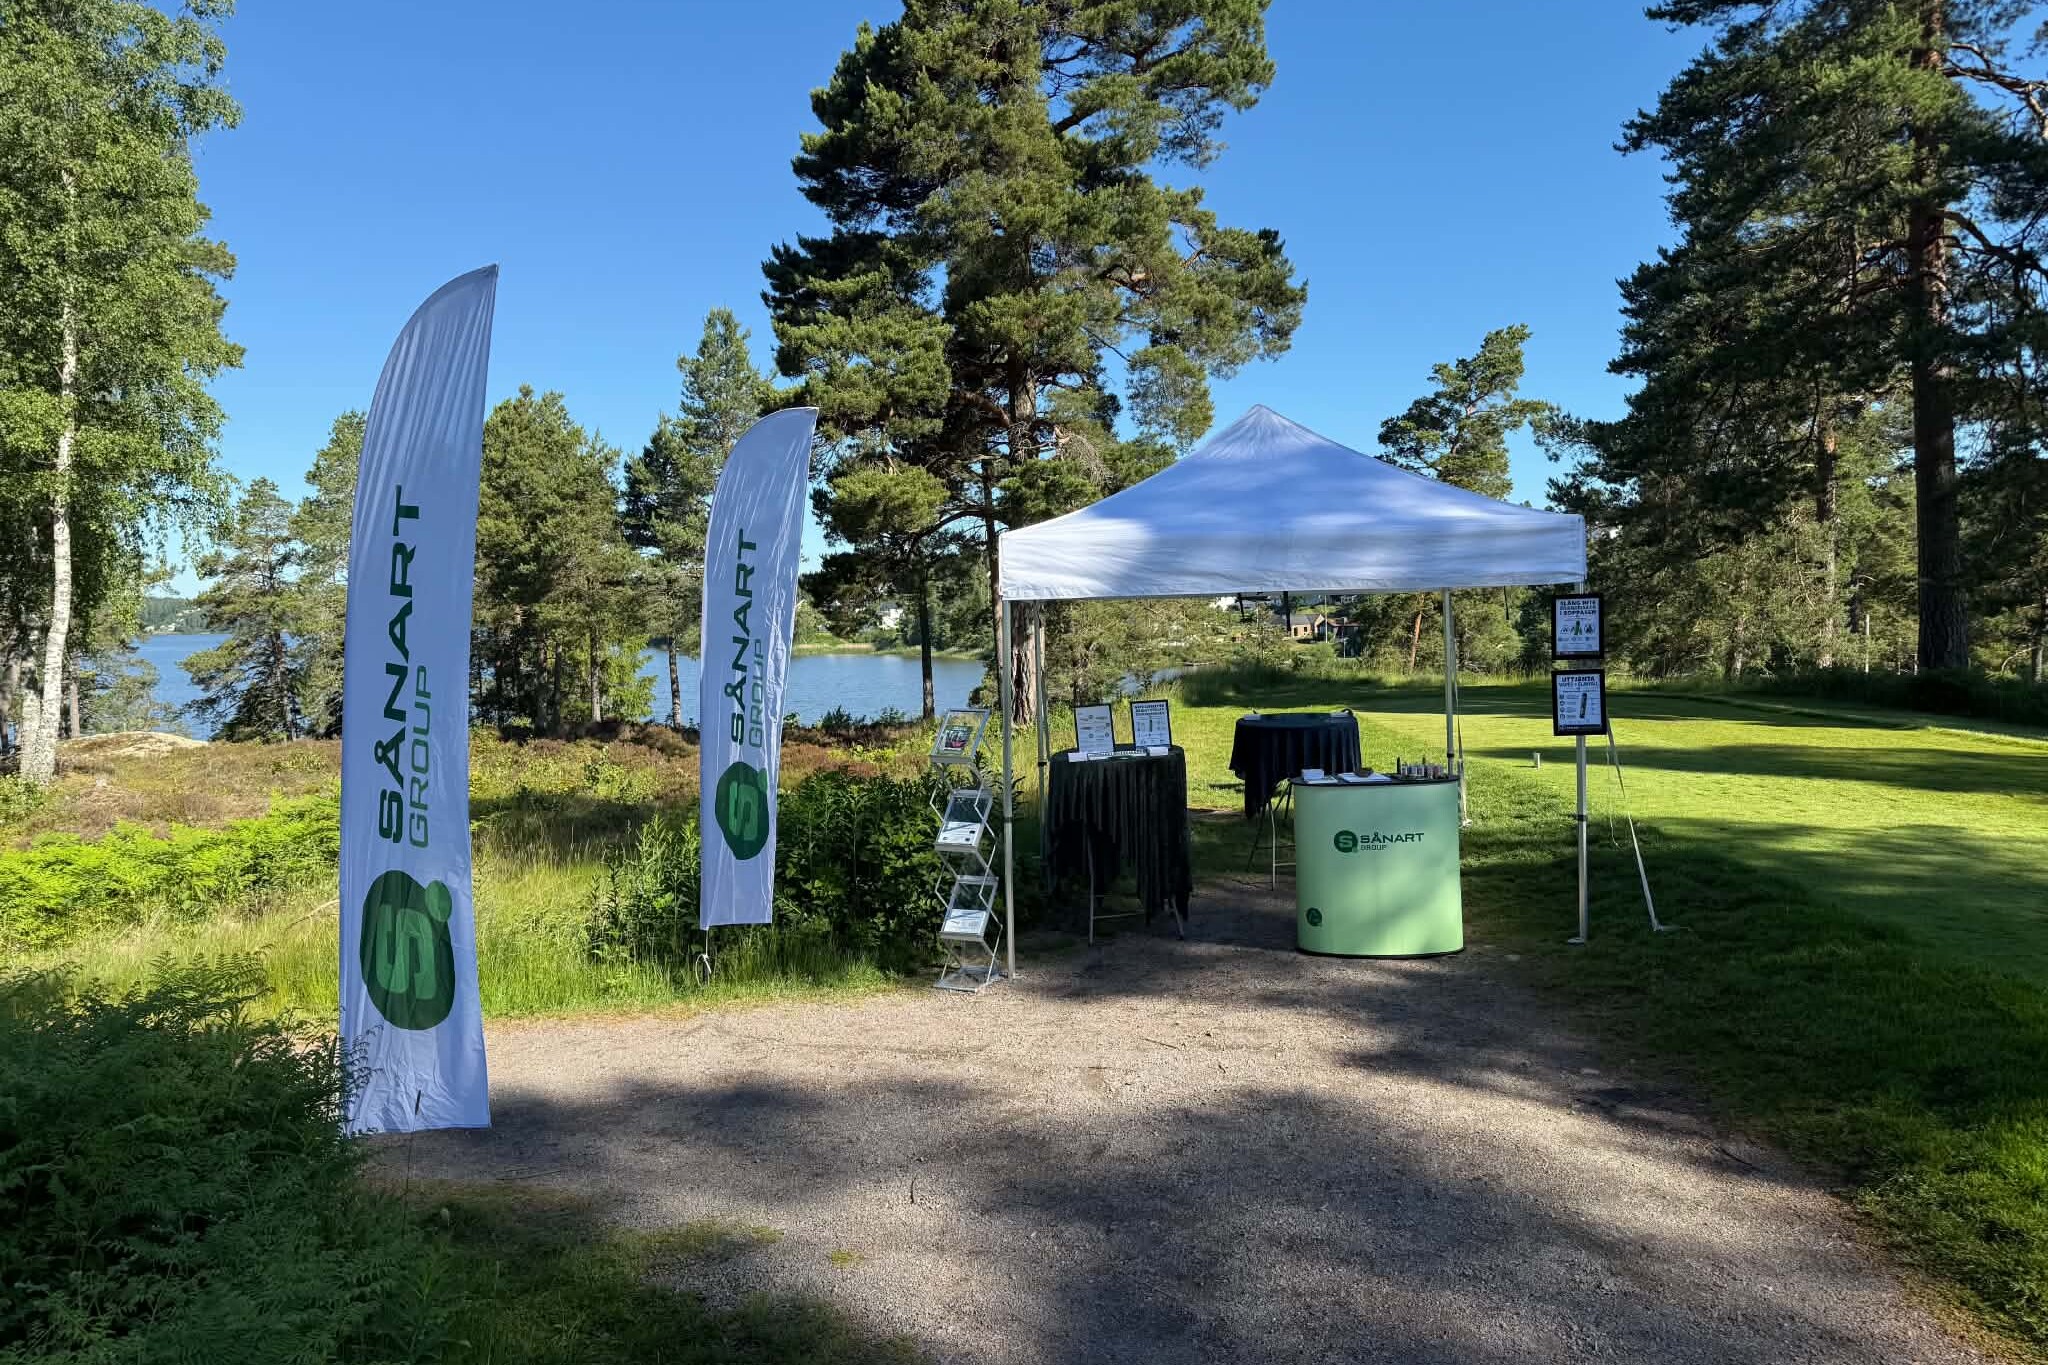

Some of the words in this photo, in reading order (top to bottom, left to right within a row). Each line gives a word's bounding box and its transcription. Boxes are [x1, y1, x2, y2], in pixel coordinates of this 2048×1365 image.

[374, 484, 420, 844] SÅNART
[724, 528, 757, 746] SÅNART
[749, 638, 764, 748] GROUP
[409, 665, 432, 849] GROUP
[1360, 831, 1425, 844] SÅNART
